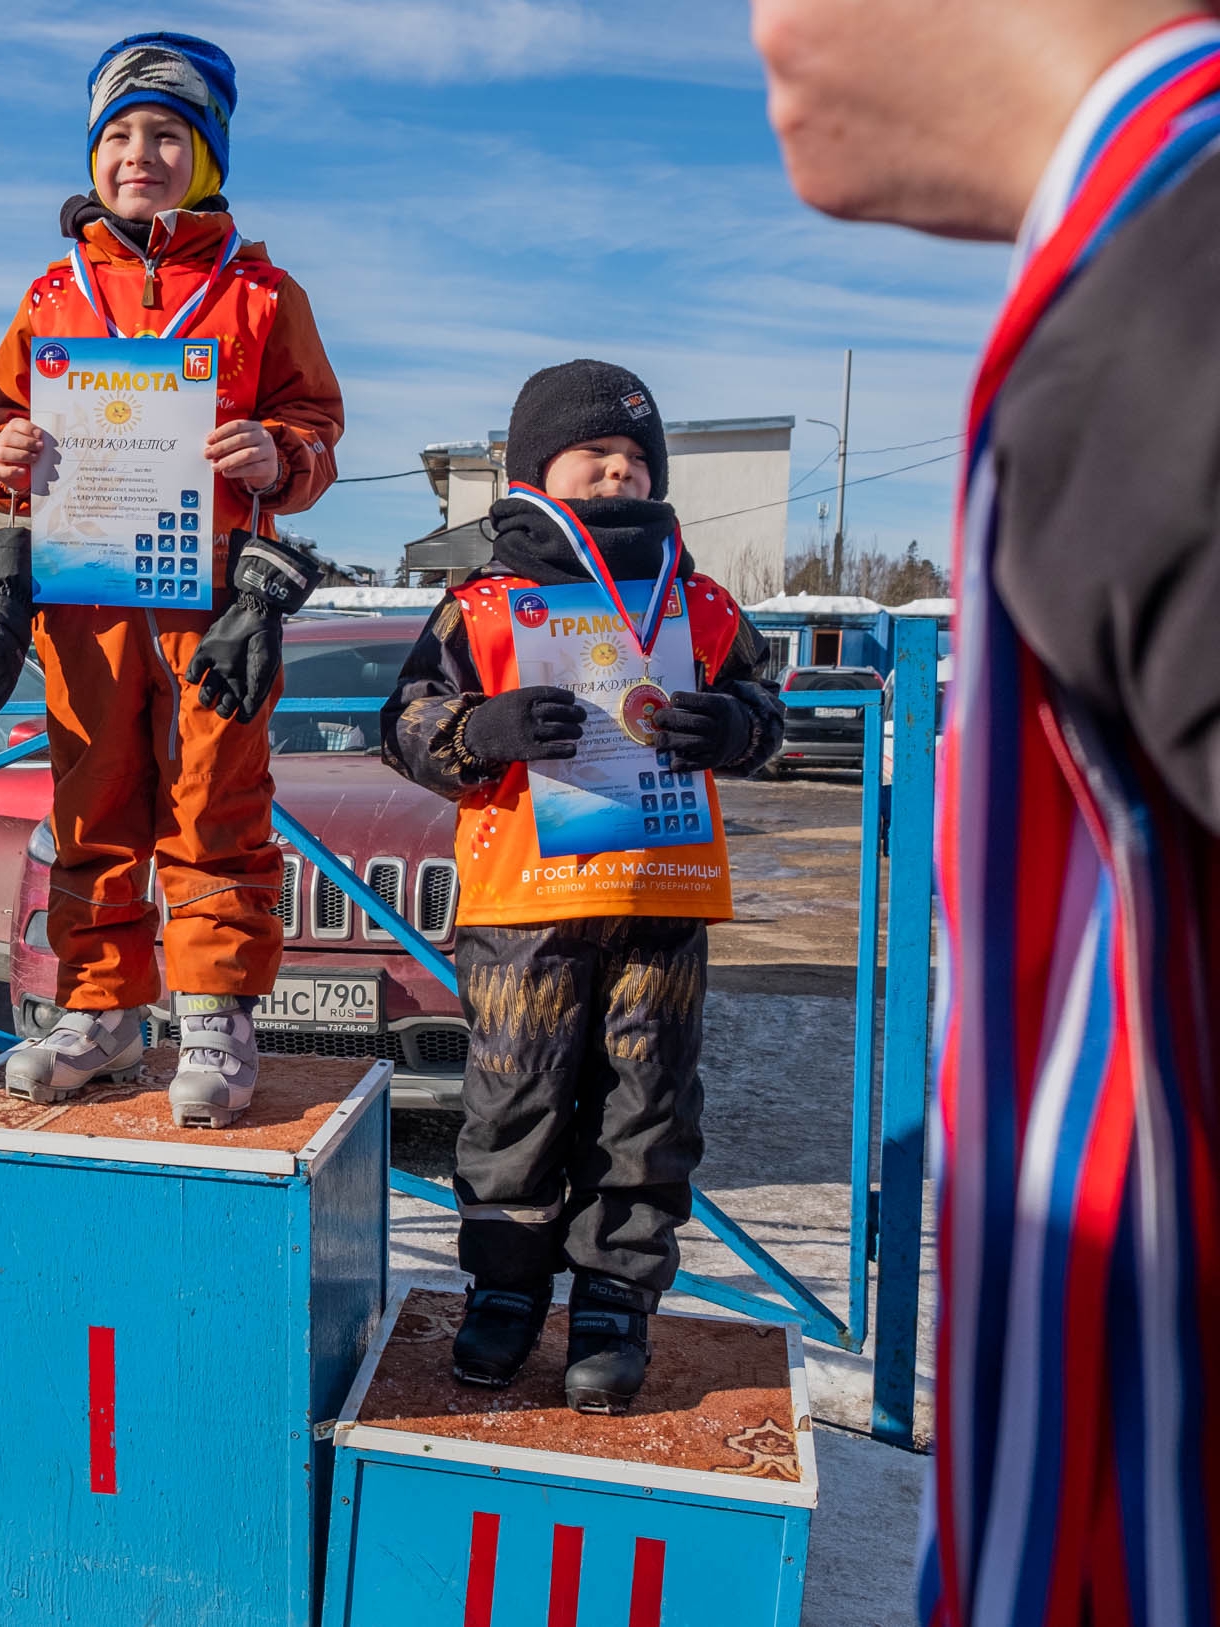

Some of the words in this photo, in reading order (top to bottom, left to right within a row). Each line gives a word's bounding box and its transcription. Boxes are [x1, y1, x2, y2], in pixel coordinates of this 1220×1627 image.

[68, 371, 179, 392] ГРАМОТА
[59, 437, 179, 452] НАГРАЖДАЕТСЯ
[549, 612, 646, 637] ГРАМО
[521, 870, 530, 883] В
[534, 864, 600, 881] ГОСТЯХ
[606, 864, 616, 876] У
[622, 863, 722, 879] МАСЛЕНИЦЫ!
[536, 886, 544, 896] С
[595, 880, 646, 890] КОМАНДА
[650, 881, 712, 892] ГУБЕРНАТОРА
[317, 983, 367, 1008] 790
[330, 1008, 355, 1018] RUS
